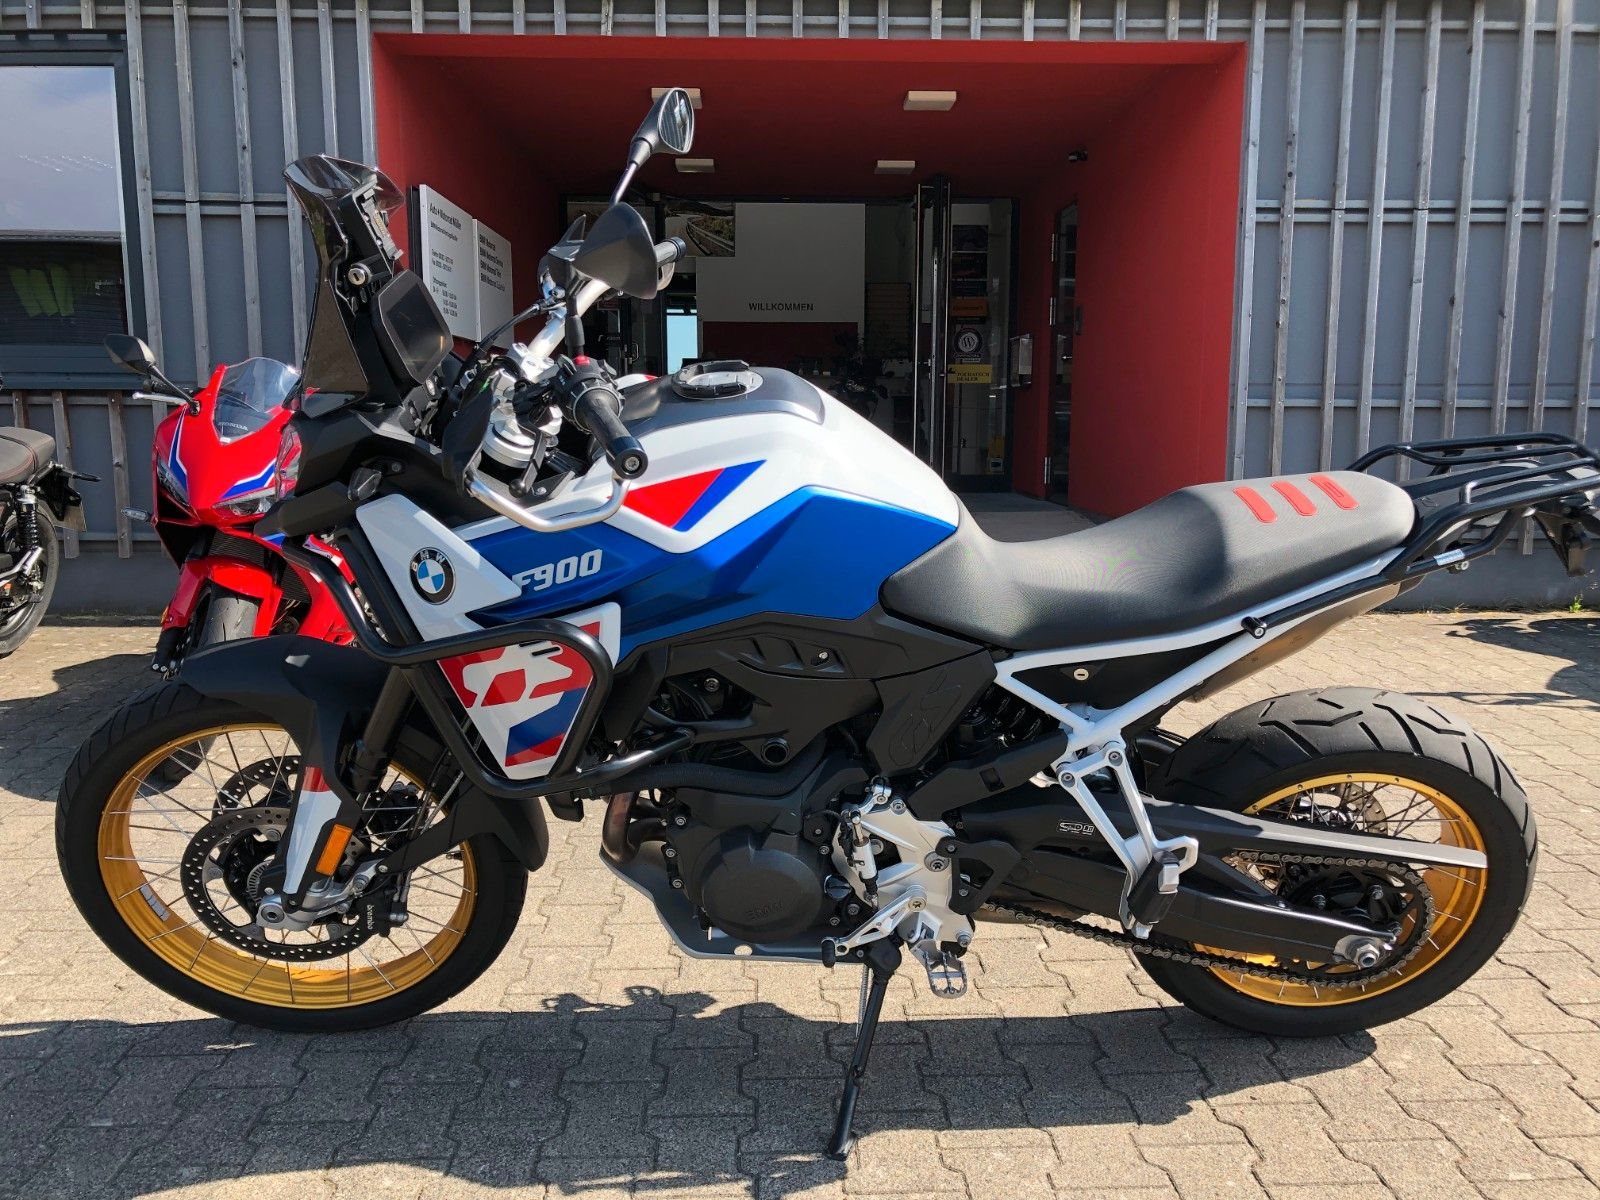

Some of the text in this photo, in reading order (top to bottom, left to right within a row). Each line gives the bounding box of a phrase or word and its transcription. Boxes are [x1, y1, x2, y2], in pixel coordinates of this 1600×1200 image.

[748, 302, 814, 311] WILLKOMMEN
[218, 422, 249, 431] HONDA
[411, 549, 446, 572] BMW
[511, 548, 603, 592] F900
[366, 904, 375, 930] brembo
